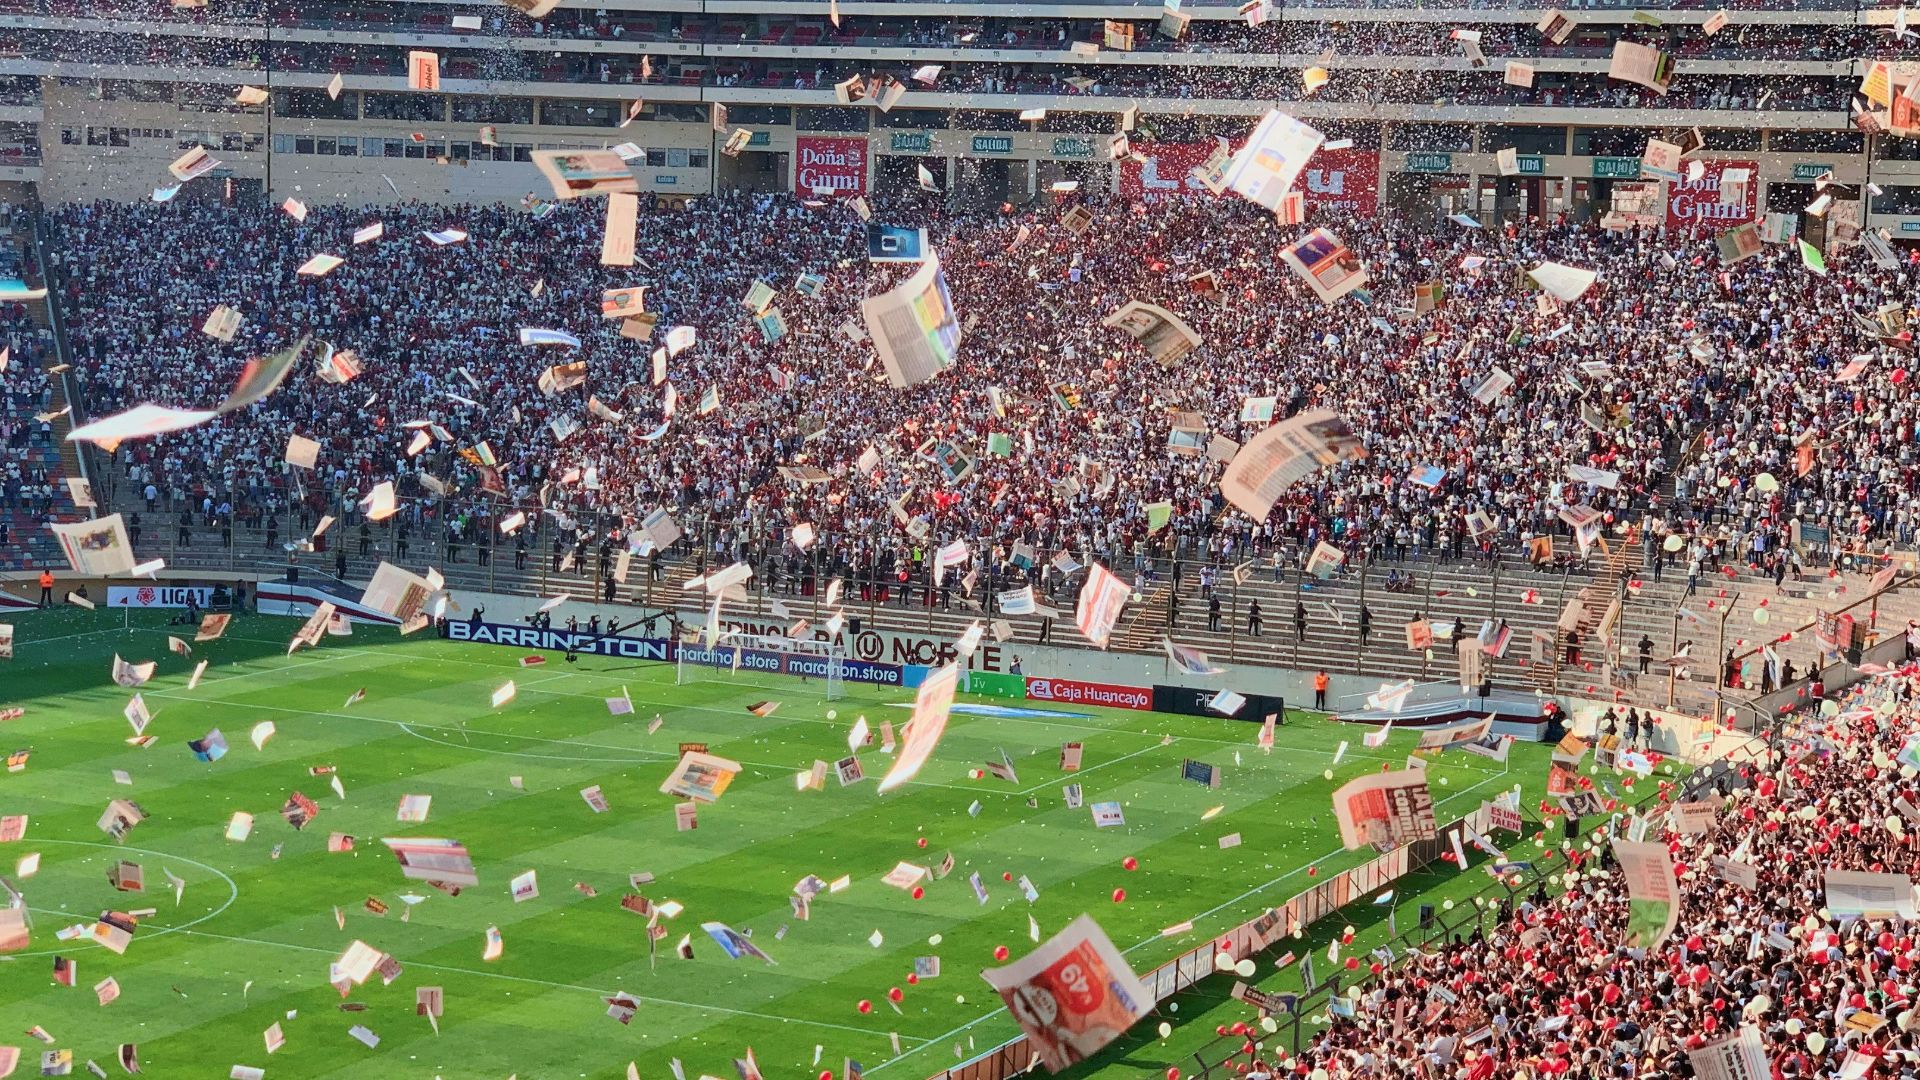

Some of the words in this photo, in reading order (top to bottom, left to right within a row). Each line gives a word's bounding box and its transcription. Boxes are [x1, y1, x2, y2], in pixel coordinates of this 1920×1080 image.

[975, 139, 1008, 150] SALIDA
[801, 147, 846, 166] Doña
[1597, 161, 1636, 174] SALIDA
[800, 168, 859, 190] Gumi
[1676, 172, 1720, 192] Doñ
[449, 620, 666, 660] BARRINGTON
[716, 619, 847, 658] RINCHRA
[893, 637, 1001, 673] NORTE
[674, 647, 779, 671] maratho.store
[789, 660, 898, 683] marathon.store
[1053, 683, 1082, 701] Caja
[1084, 686, 1148, 709] Huancayo
[1491, 806, 1502, 816] ES
[1503, 809, 1522, 822] UNA
